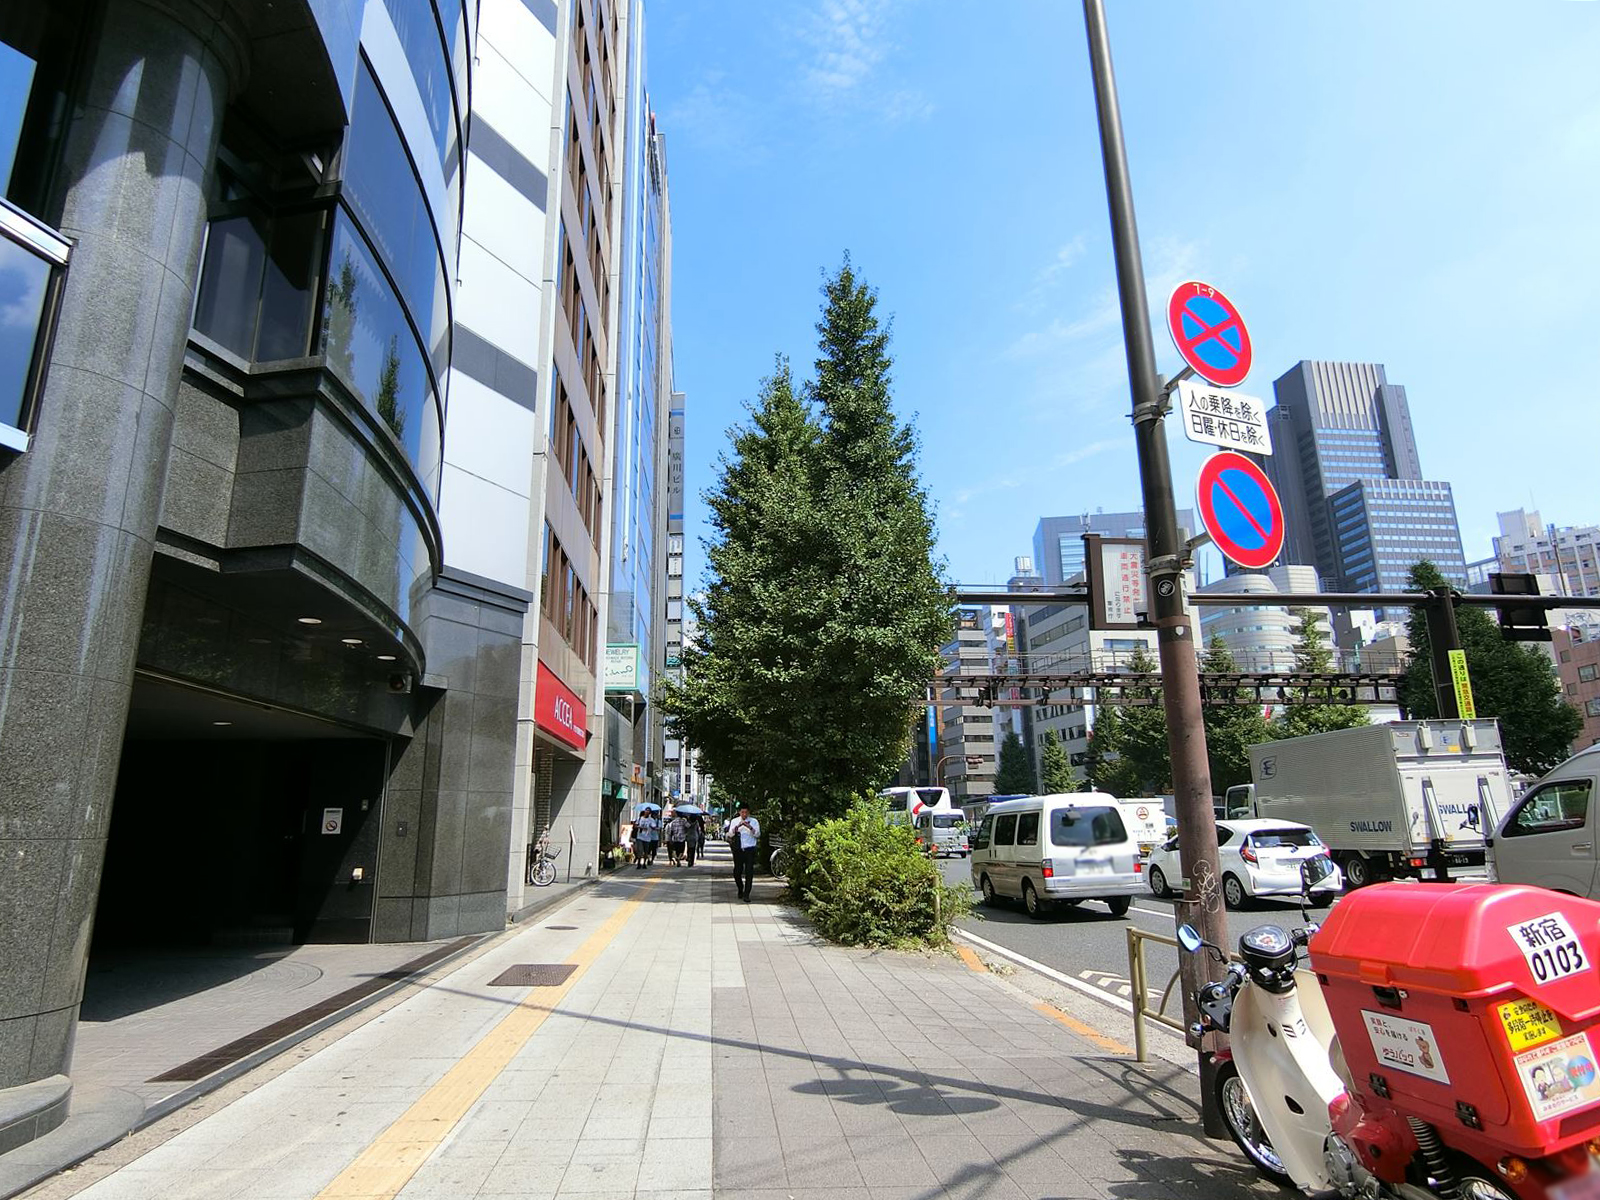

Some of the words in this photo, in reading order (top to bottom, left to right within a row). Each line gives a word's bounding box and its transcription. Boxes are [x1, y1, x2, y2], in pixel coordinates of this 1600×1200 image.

[1192, 283, 1215, 298] 7-9
[1189, 389, 1261, 423] 人の乗降を除く
[553, 695, 573, 730] ACCEA
[1350, 821, 1393, 832] SWALLOW
[1519, 918, 1566, 948] 新宿
[1532, 940, 1583, 981] 0103
[1382, 1047, 1414, 1064] ゆうパック
